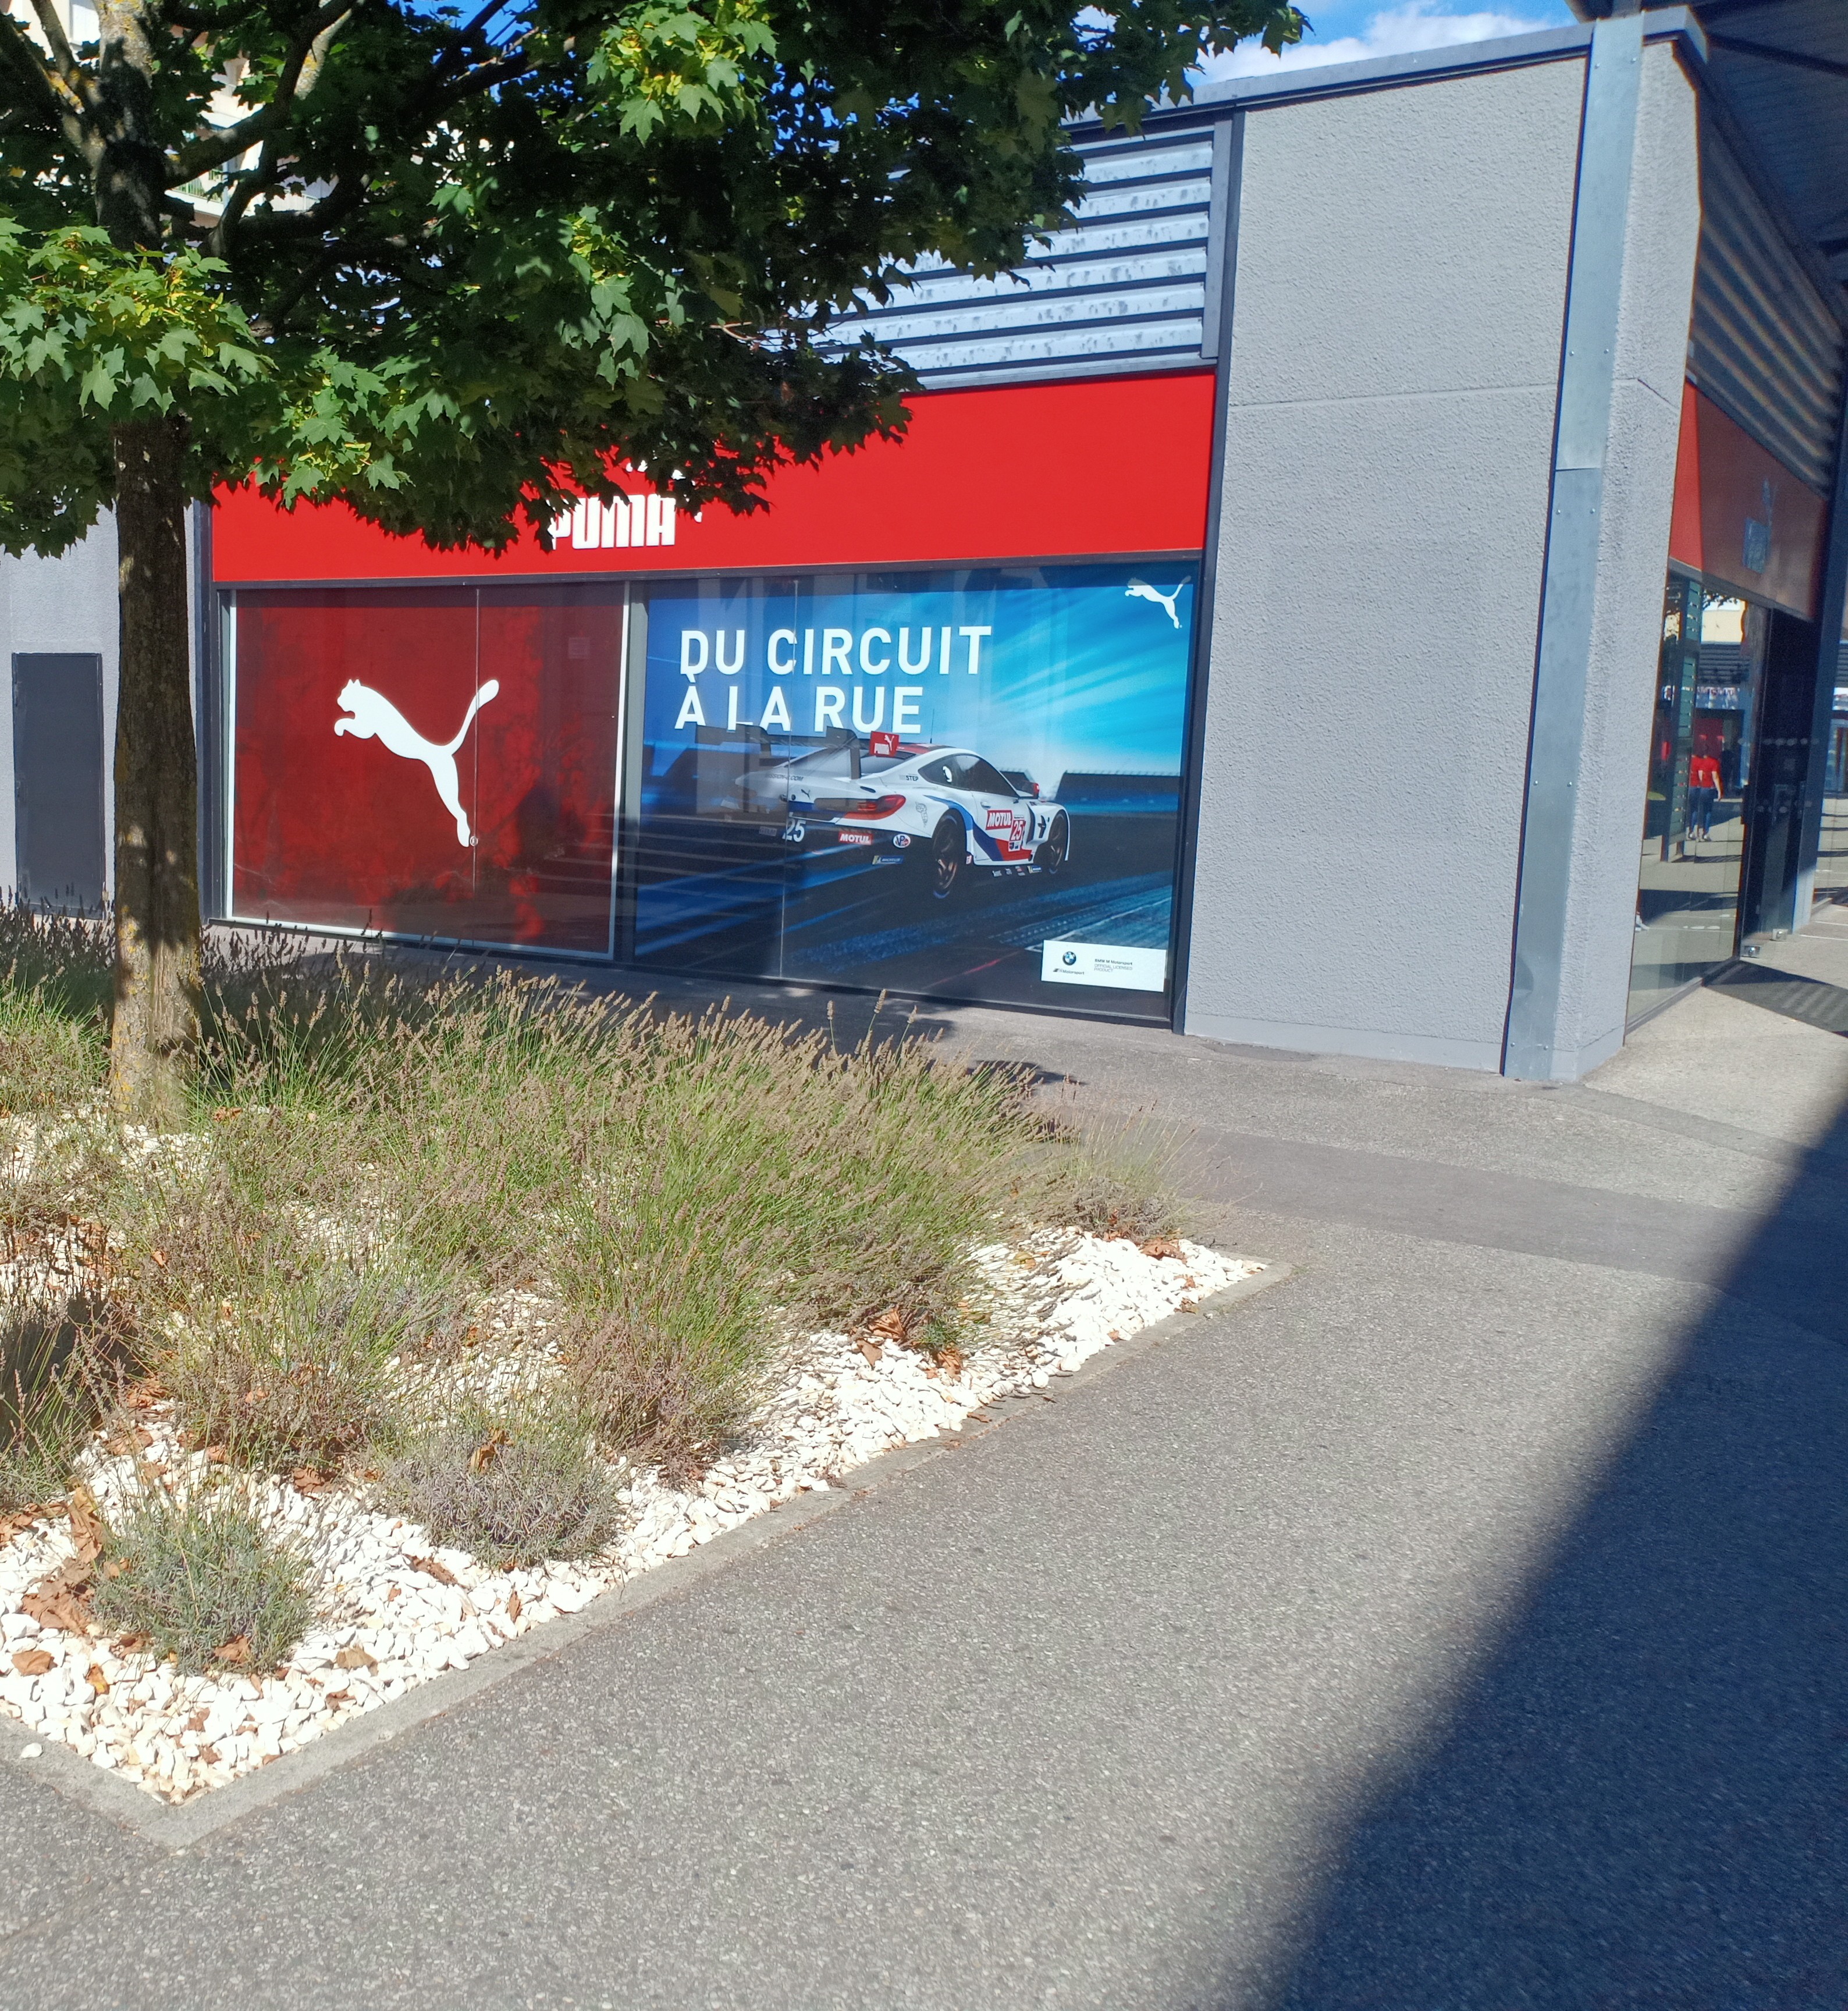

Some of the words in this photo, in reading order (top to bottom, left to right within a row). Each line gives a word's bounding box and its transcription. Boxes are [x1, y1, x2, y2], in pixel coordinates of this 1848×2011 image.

[680, 630, 745, 675] DU
[767, 626, 992, 676] CIRCUIT
[727, 685, 791, 731] LA
[814, 686, 923, 734] RUE
[781, 817, 806, 843] 25
[987, 812, 1012, 827] MOTUL
[1010, 820, 1023, 841] 25
[839, 833, 872, 844] MOTUL
